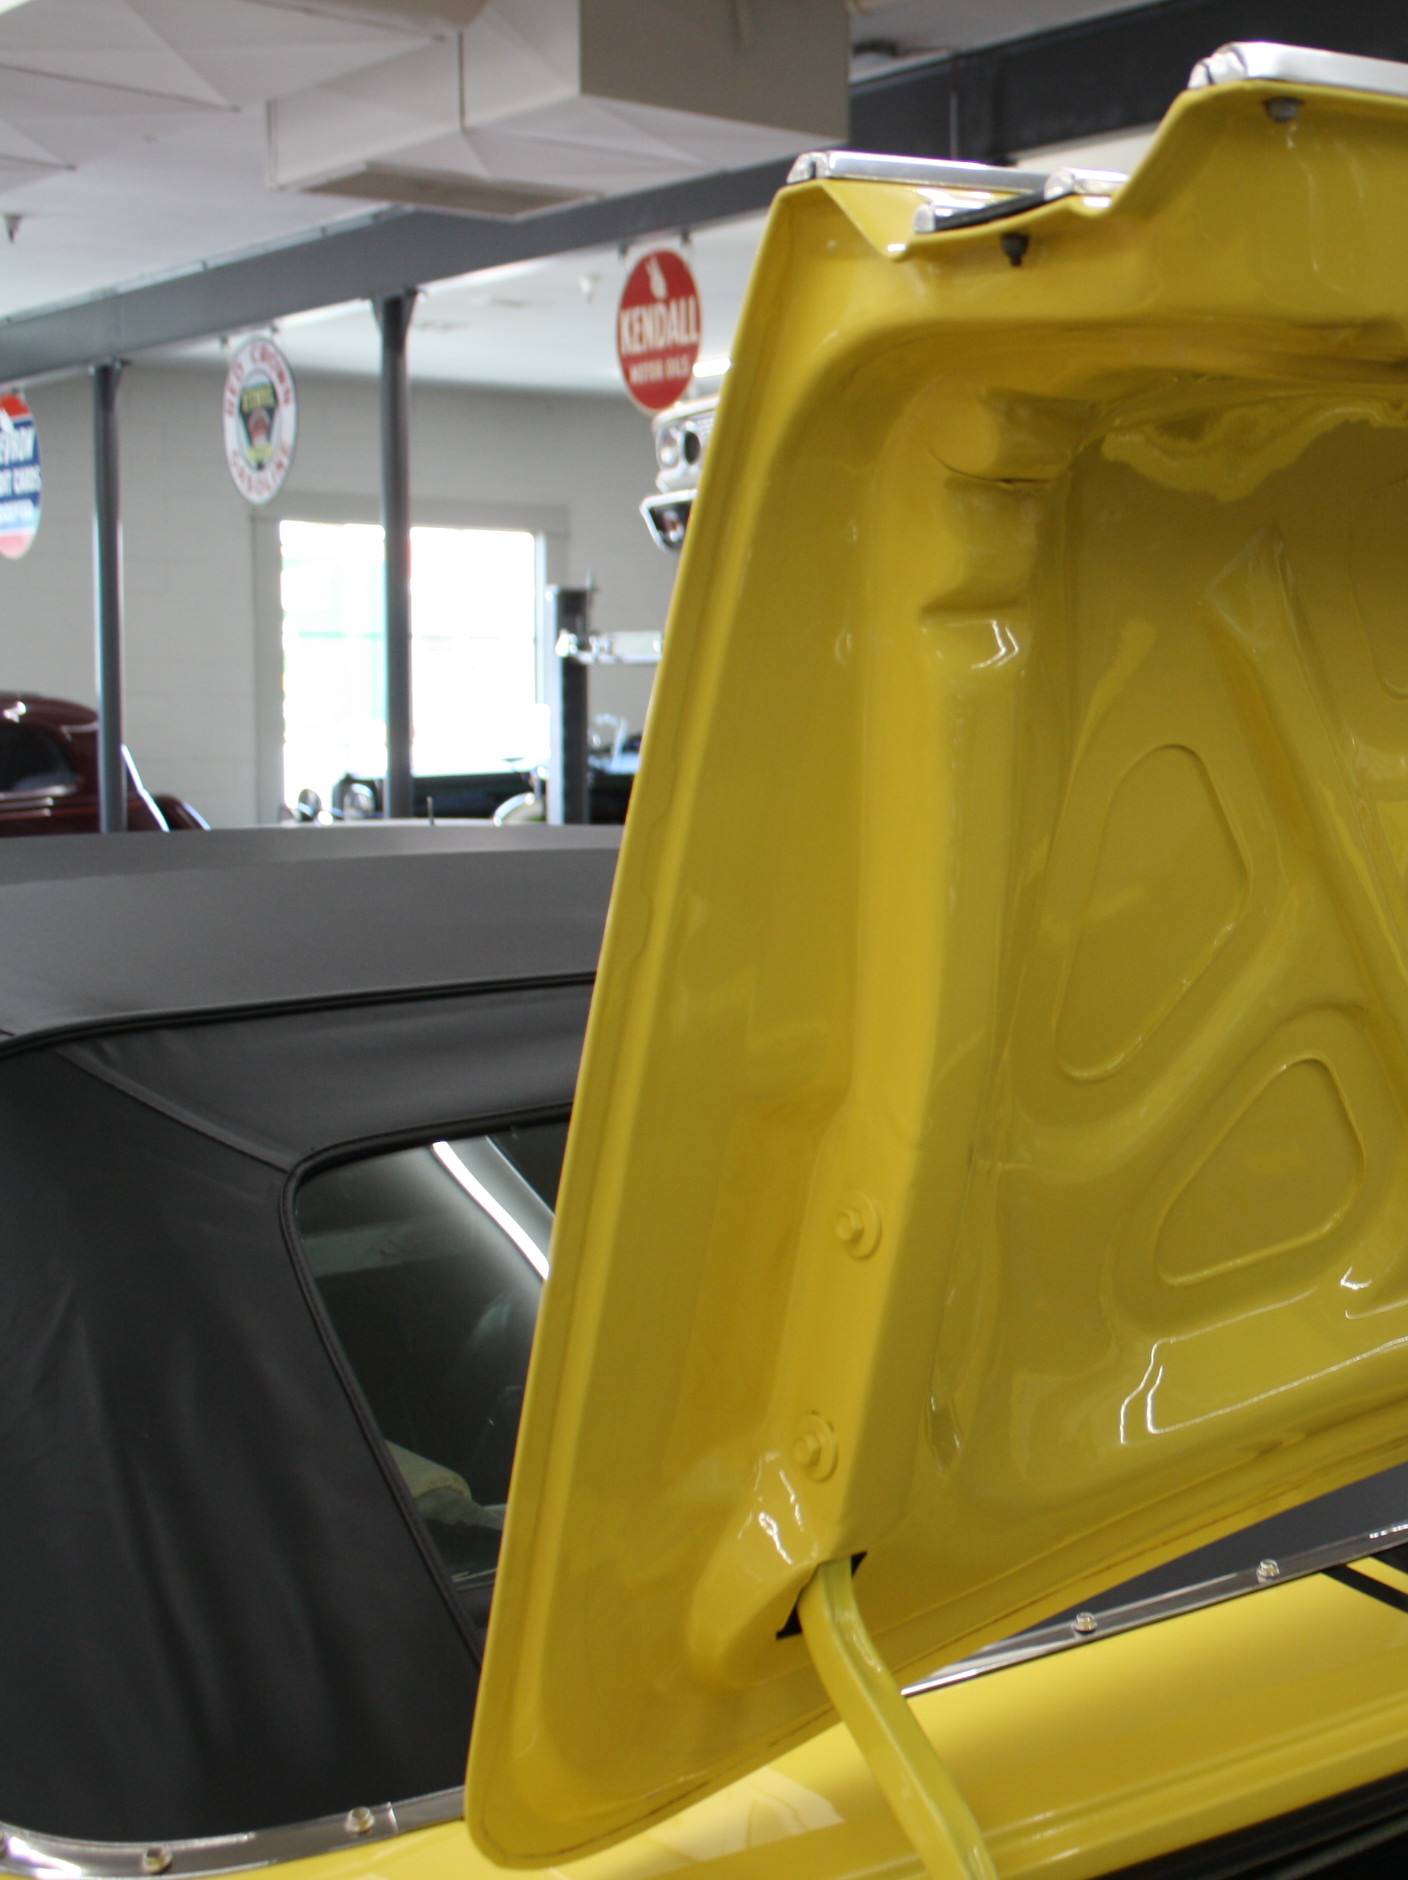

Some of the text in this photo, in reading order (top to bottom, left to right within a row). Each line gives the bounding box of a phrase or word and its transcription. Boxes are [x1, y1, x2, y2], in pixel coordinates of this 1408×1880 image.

[620, 294, 699, 357] KENDALL
[250, 342, 292, 406] CROWN
[629, 354, 691, 384] MOTOR OILS
[232, 442, 292, 495] GASOLINE
